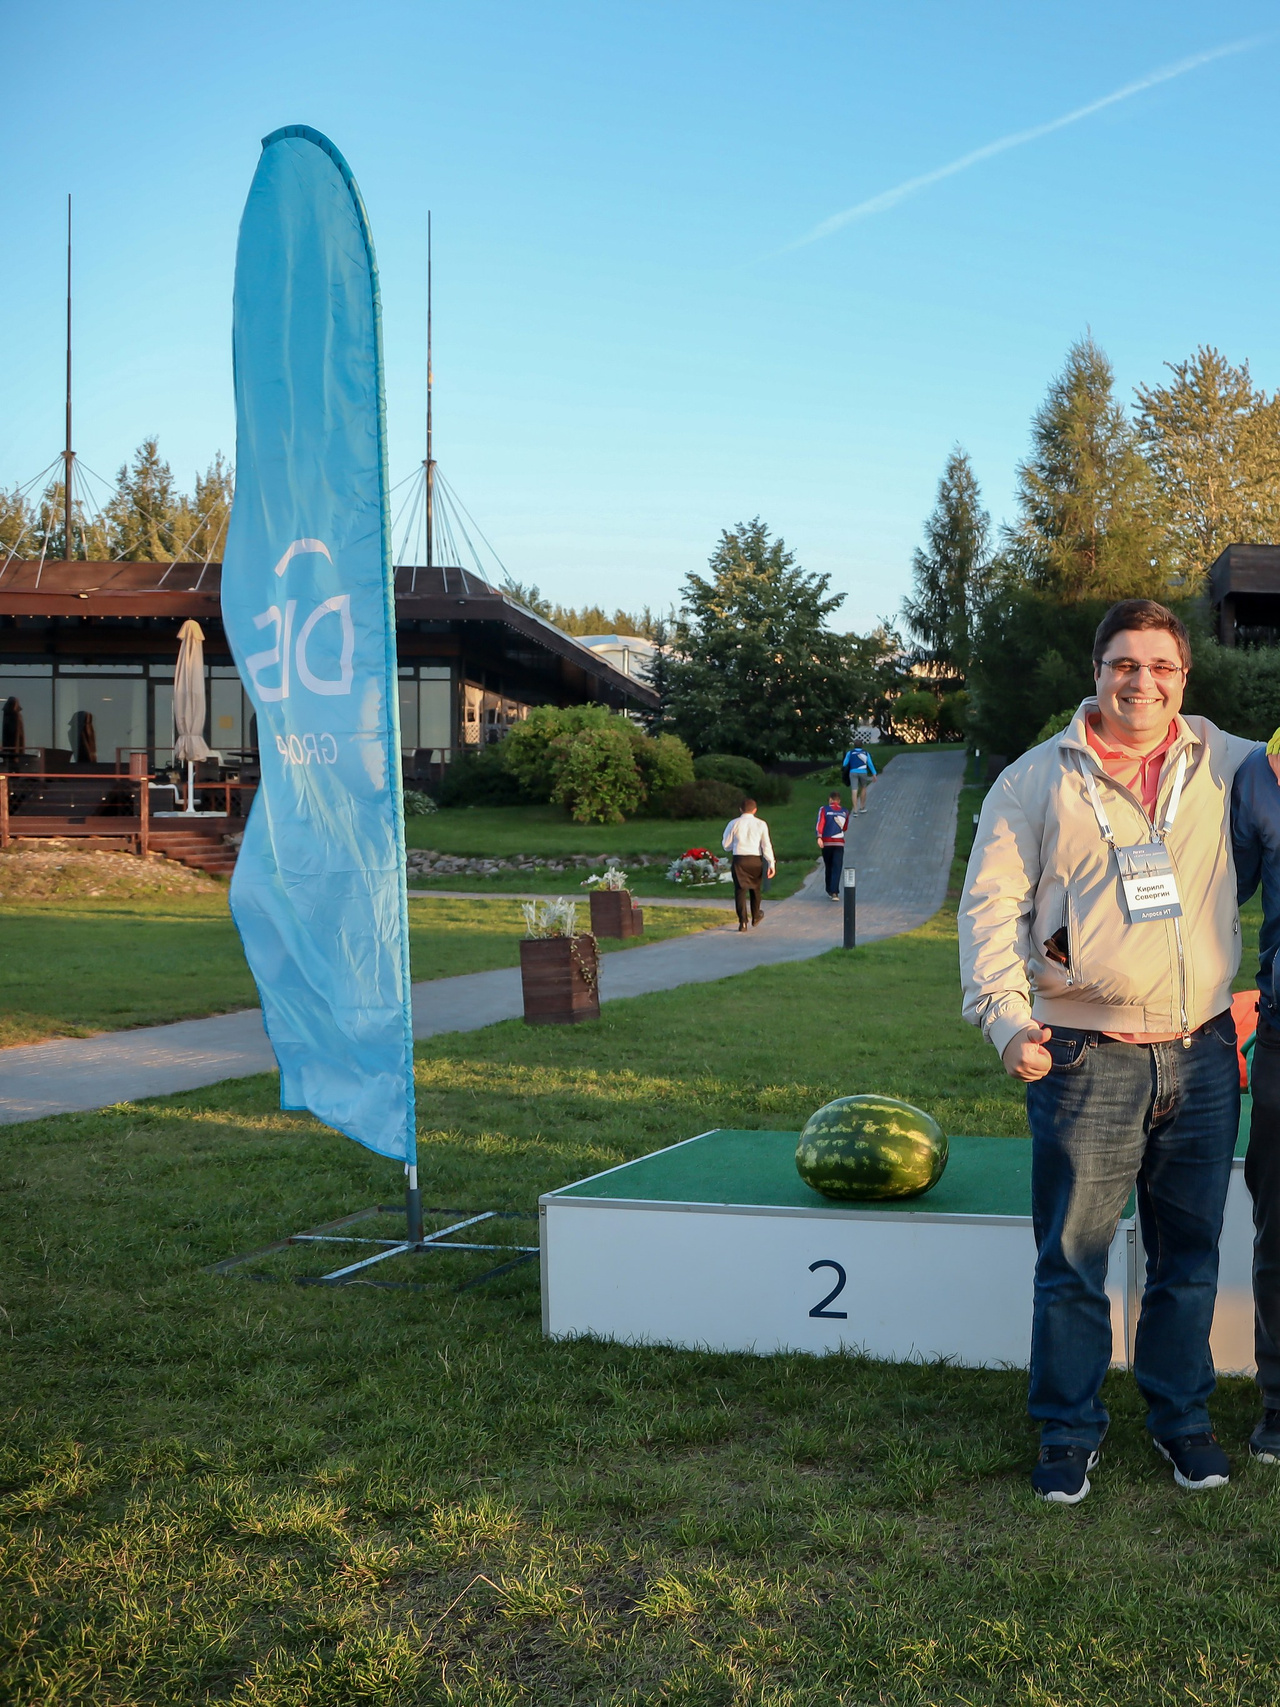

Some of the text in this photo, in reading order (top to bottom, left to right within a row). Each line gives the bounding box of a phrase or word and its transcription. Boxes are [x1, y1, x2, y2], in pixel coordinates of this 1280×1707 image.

[1137, 884, 1165, 892] Кирилл
[1135, 891, 1170, 900] Севергин
[808, 1259, 848, 1319] 2
